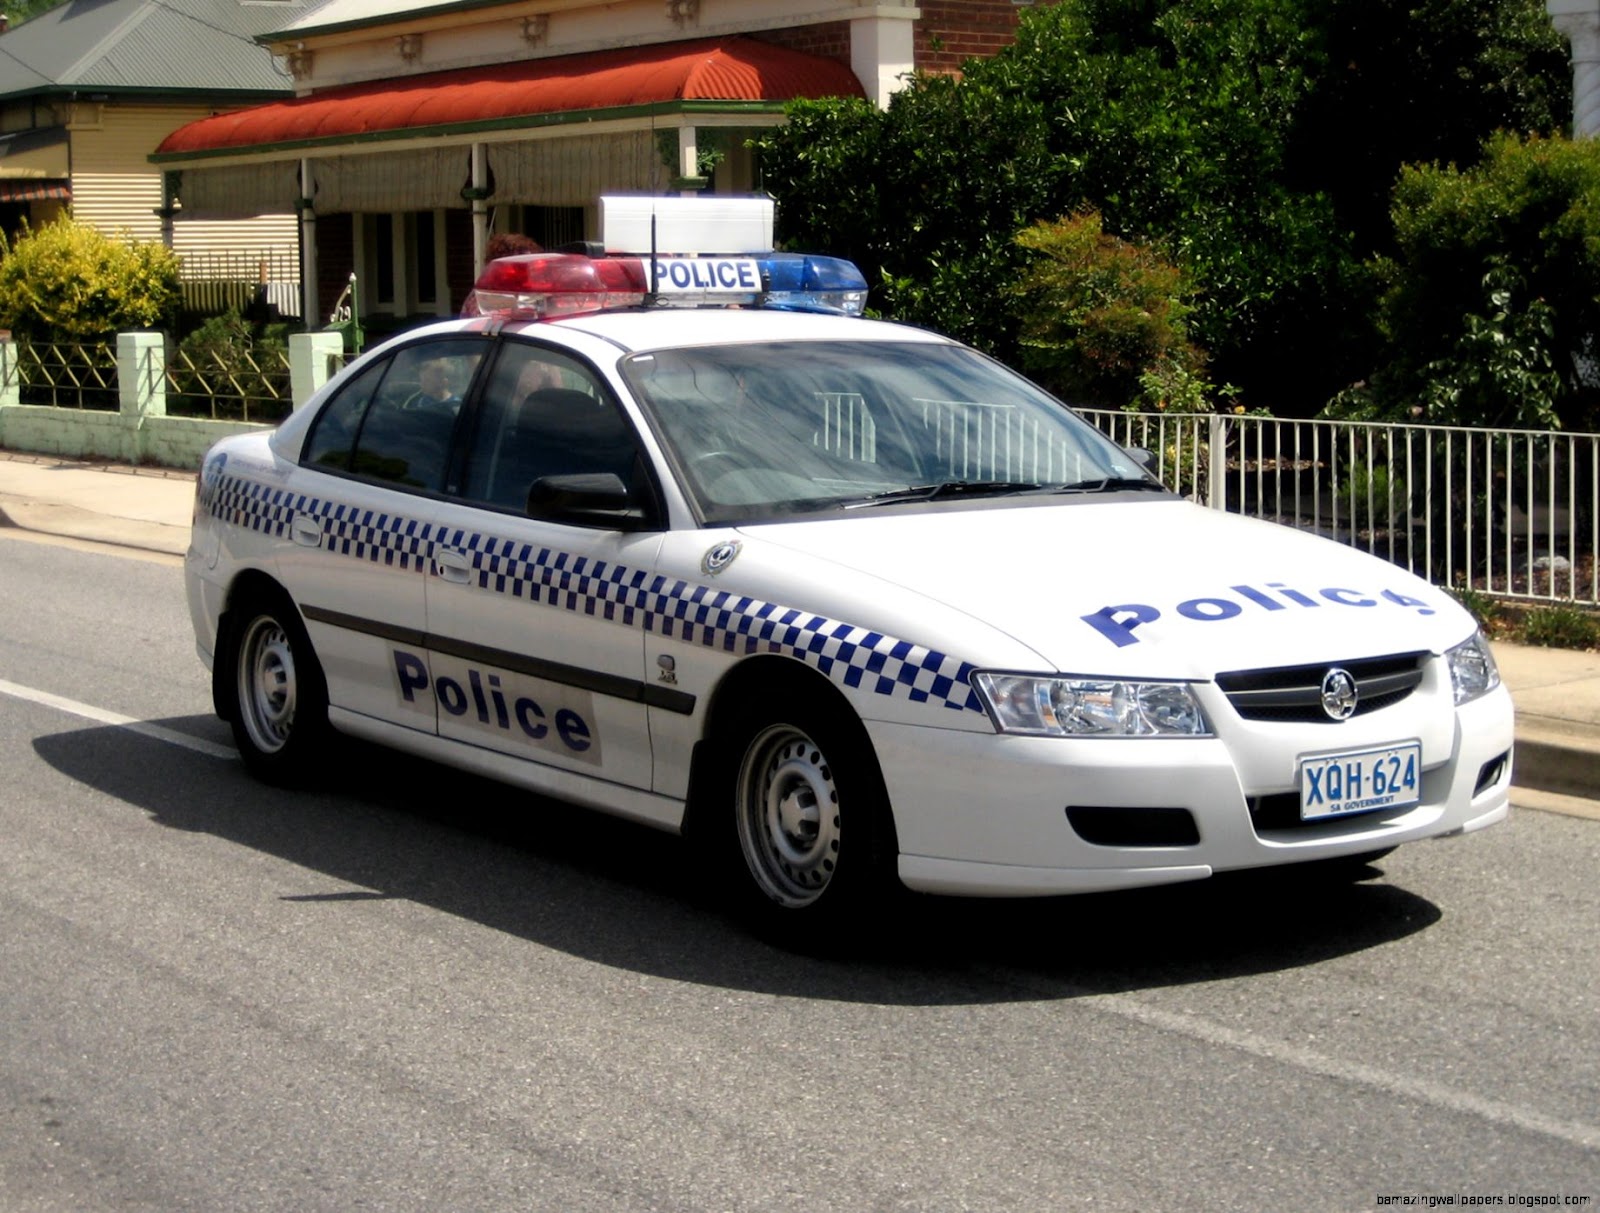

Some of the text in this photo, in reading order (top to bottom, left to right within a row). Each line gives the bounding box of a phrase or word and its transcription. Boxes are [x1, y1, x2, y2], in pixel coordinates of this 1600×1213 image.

[655, 261, 755, 288] POLICE
[394, 650, 591, 752] Police
[1330, 795, 1394, 813] SA GOVERNMENT
